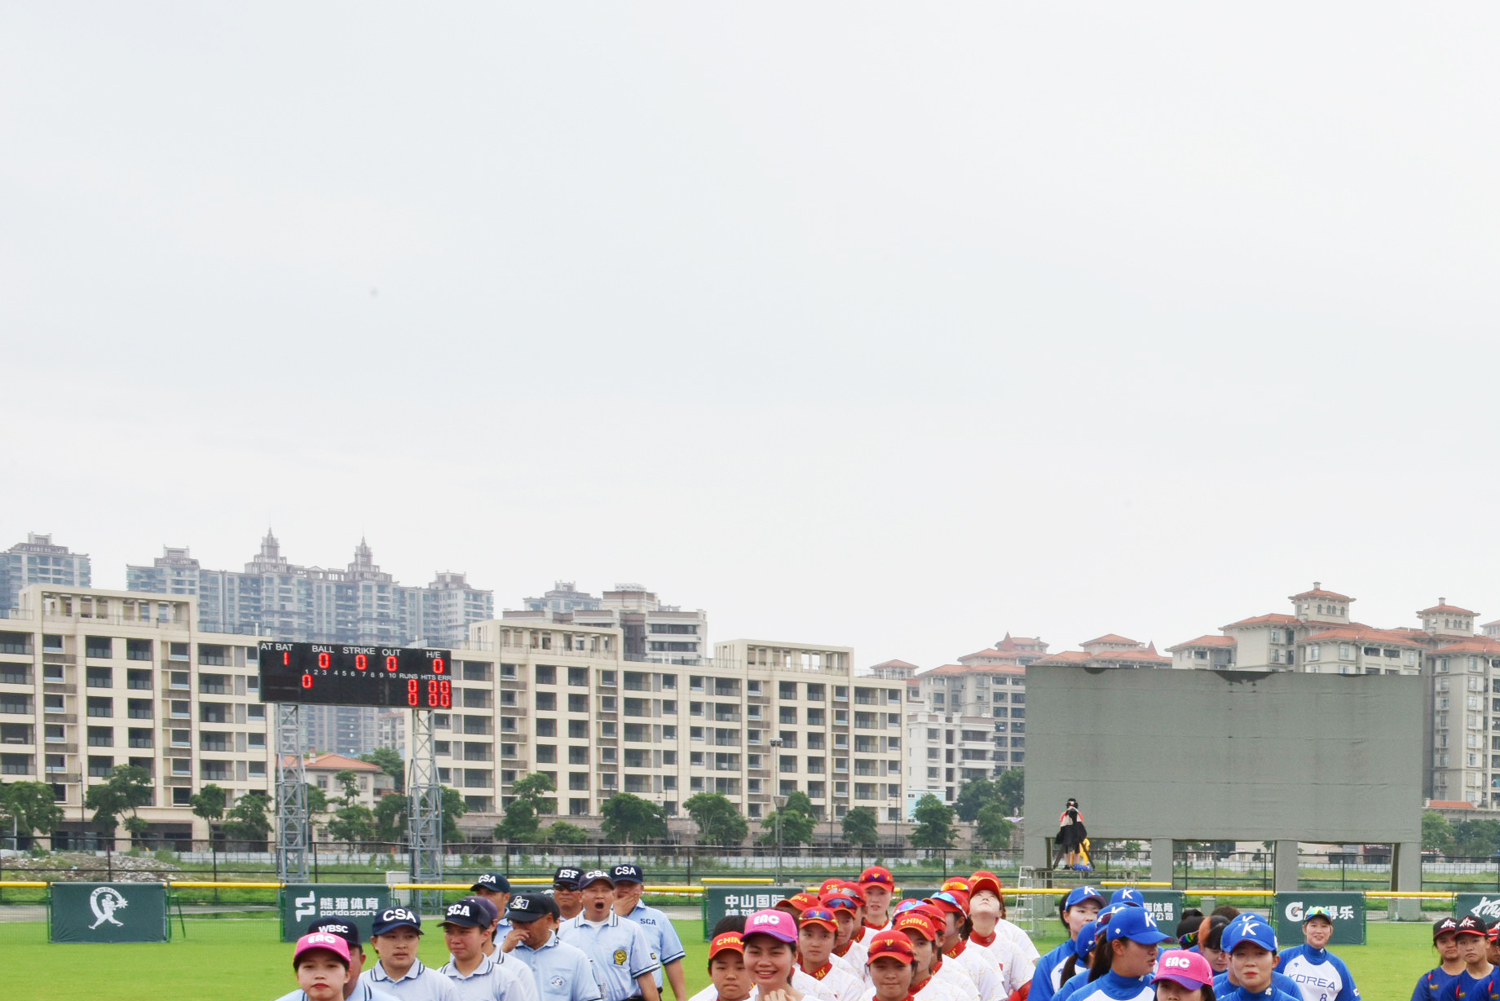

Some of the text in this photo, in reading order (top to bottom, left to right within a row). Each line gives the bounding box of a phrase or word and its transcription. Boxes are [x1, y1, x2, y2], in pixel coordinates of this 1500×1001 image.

[312, 645, 335, 653] BALL
[343, 647, 376, 655] STRIKE
[382, 648, 400, 656] OUT
[319, 652, 330, 669] 0
[356, 654, 367, 670] 0
[386, 656, 397, 672] 0
[433, 658, 444, 674] 0
[302, 674, 313, 689] 0
[559, 869, 579, 879] ISF
[615, 866, 636, 876] CSA
[478, 874, 496, 884] CSA
[1084, 886, 1096, 896] K
[1122, 889, 1134, 899] K
[320, 897, 379, 910] 熊猫体育
[383, 908, 417, 923] CSA
[446, 903, 470, 917] SCA
[640, 918, 657, 926] SCA
[753, 914, 780, 925] EAC
[900, 918, 929, 929] CHINA
[1144, 911, 1157, 928] K
[318, 924, 349, 933] WBSC
[1242, 922, 1259, 936] K
[308, 934, 336, 944] EAC
[716, 936, 743, 946] CHIN
[1165, 957, 1190, 968] EAC
[1289, 973, 1336, 991] KOREA
